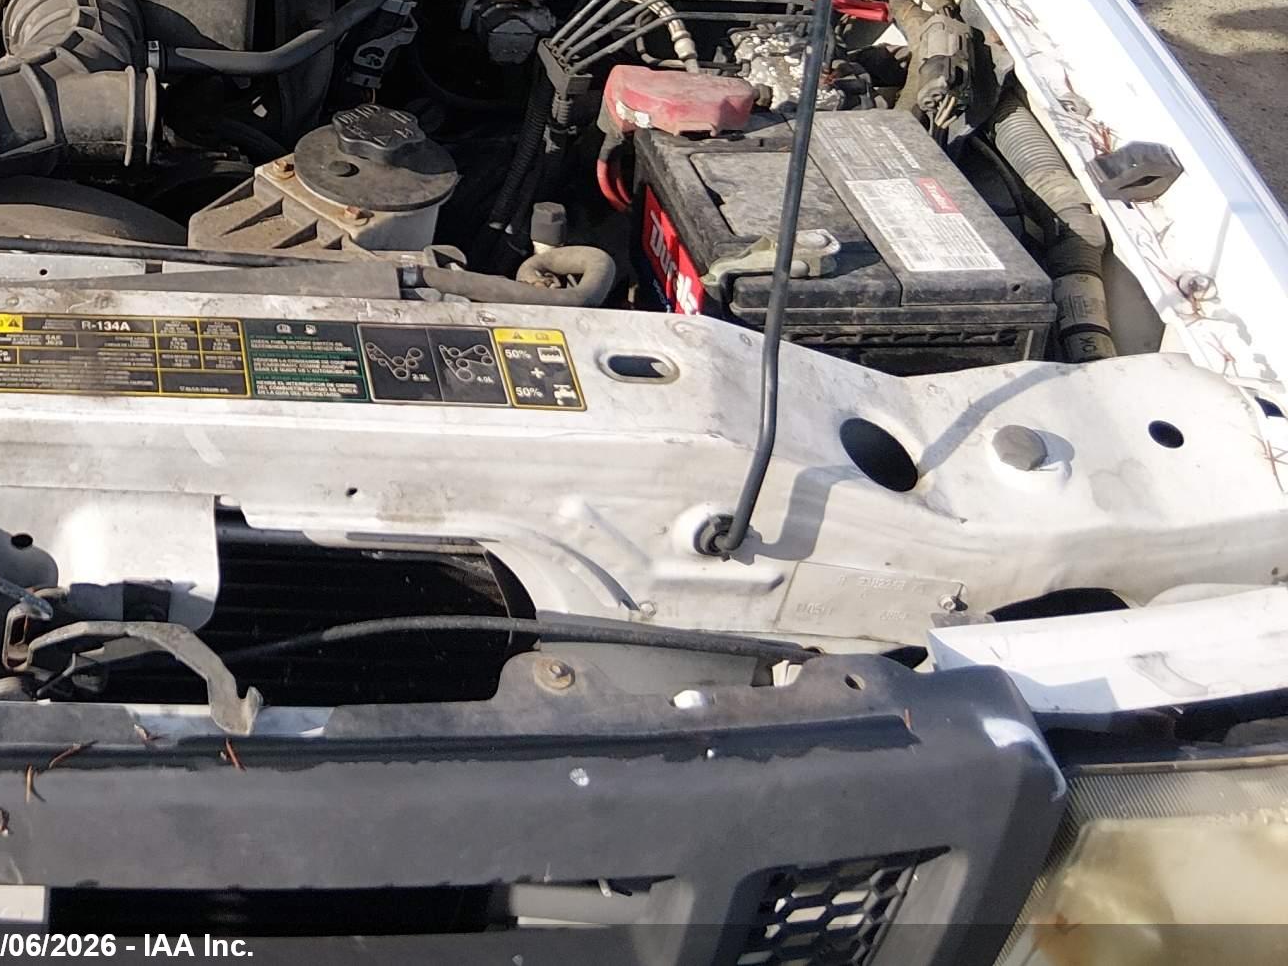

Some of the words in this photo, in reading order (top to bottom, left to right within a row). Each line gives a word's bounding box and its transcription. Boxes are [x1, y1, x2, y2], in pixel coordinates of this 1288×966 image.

[81, 320, 131, 332] R-134A
[505, 348, 531, 360] 50%
[515, 386, 544, 398] 50%
